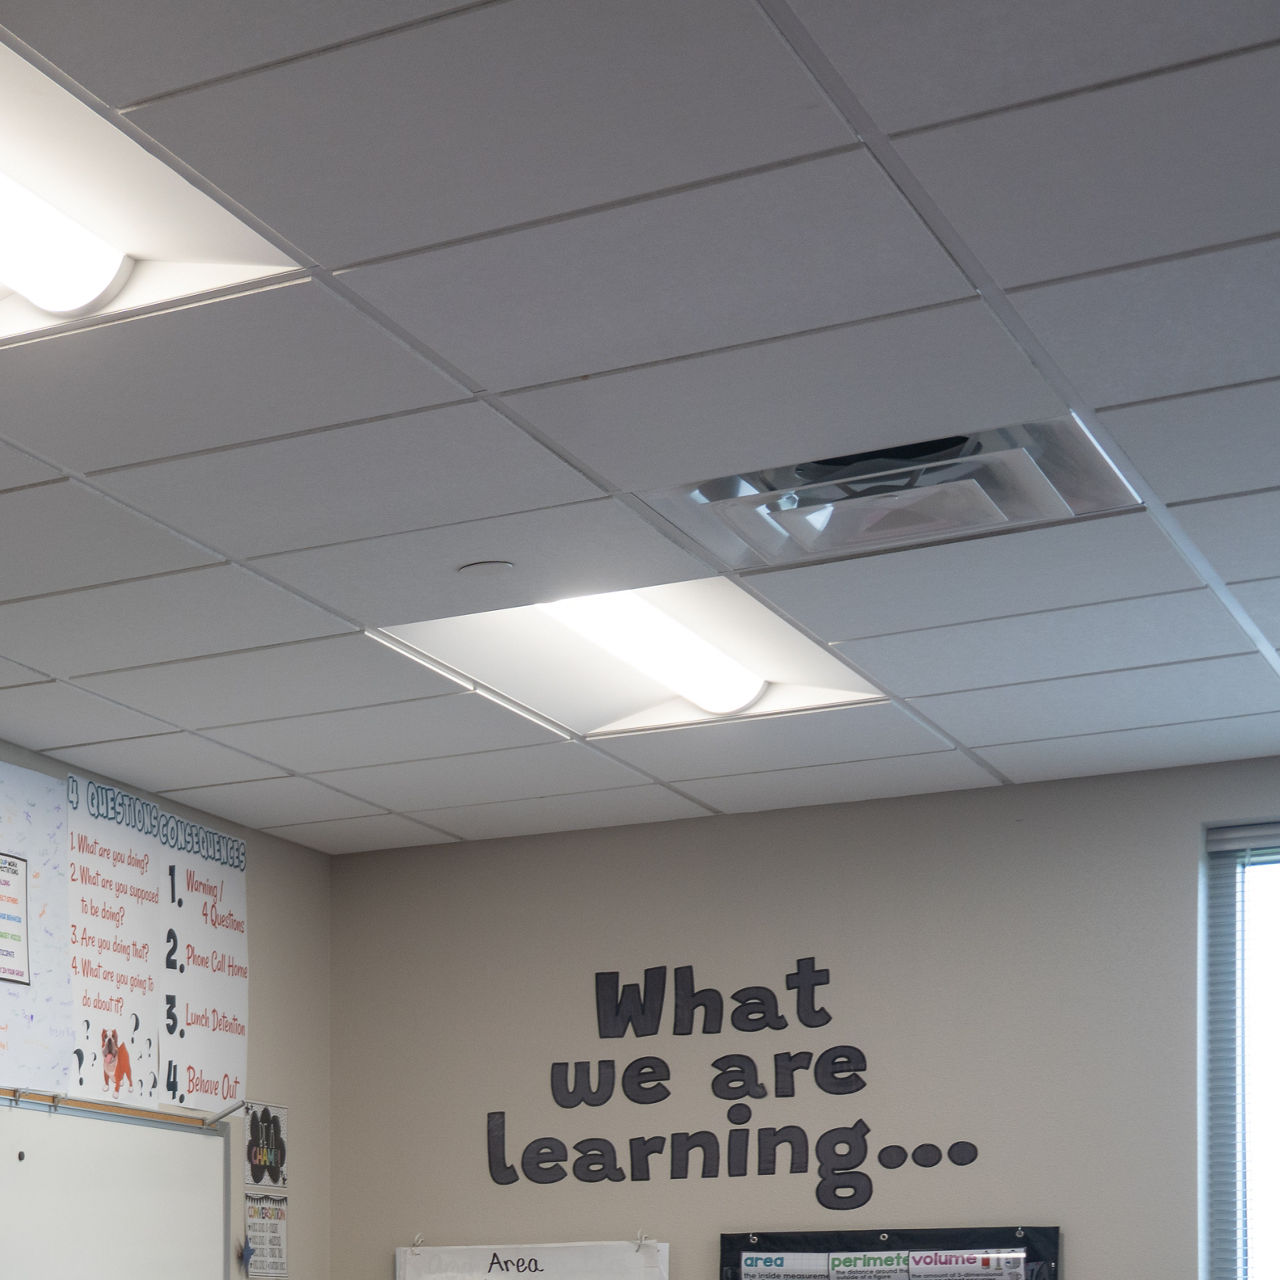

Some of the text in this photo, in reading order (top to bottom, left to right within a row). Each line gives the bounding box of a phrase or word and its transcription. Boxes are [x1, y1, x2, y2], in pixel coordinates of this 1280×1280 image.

[68, 776, 158, 838] 4 QUESTIONS
[78, 833, 98, 853] What
[99, 845, 111, 859] are
[113, 851, 125, 867] you
[128, 849, 149, 875] doing?
[158, 814, 246, 871] CONSEQUENCES
[169, 865, 217, 908] 1. Warning
[202, 904, 244, 934] 4 Questions
[166, 928, 248, 979] 2. Phone Call Home
[166, 995, 246, 1038] 3. Lunch Detention
[595, 956, 832, 1038] What
[166, 1061, 239, 1103] 4. Behave Out
[551, 1045, 867, 1109] we are
[487, 1103, 978, 1211] learning...
[488, 1252, 544, 1273] Area
[744, 1256, 784, 1268] area
[912, 1253, 977, 1266] volume
